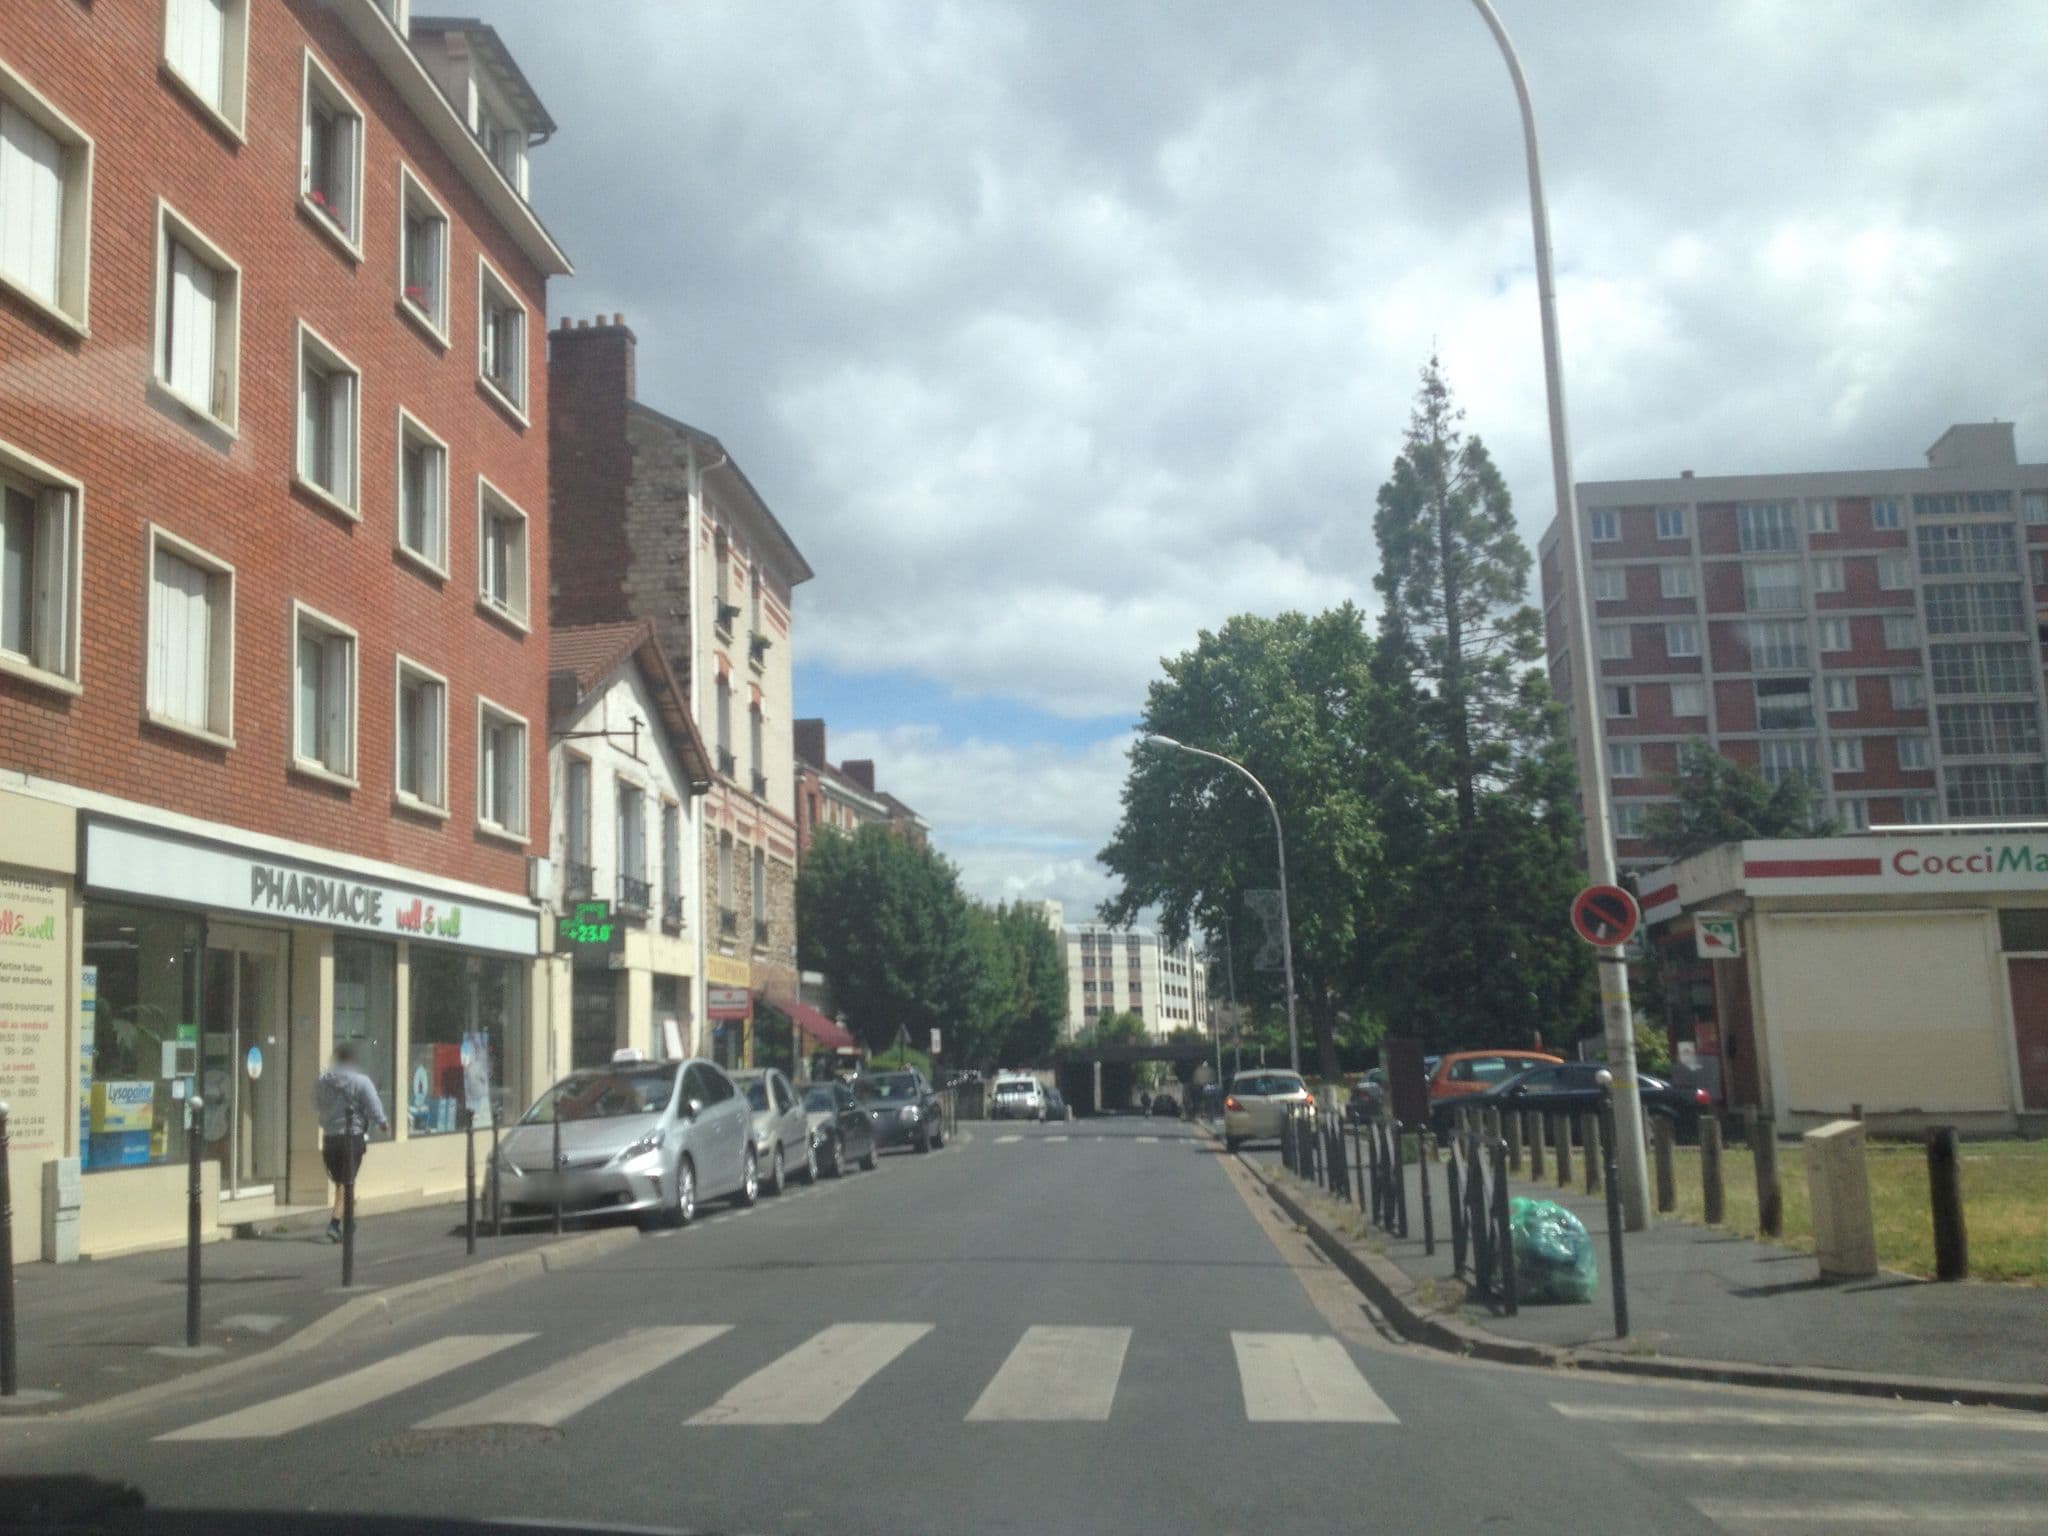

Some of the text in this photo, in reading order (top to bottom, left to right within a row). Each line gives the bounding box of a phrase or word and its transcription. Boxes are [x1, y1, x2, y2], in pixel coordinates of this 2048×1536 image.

[251, 865, 383, 926] PHARMACIE
[396, 898, 423, 933] well
[437, 906, 461, 938] well
